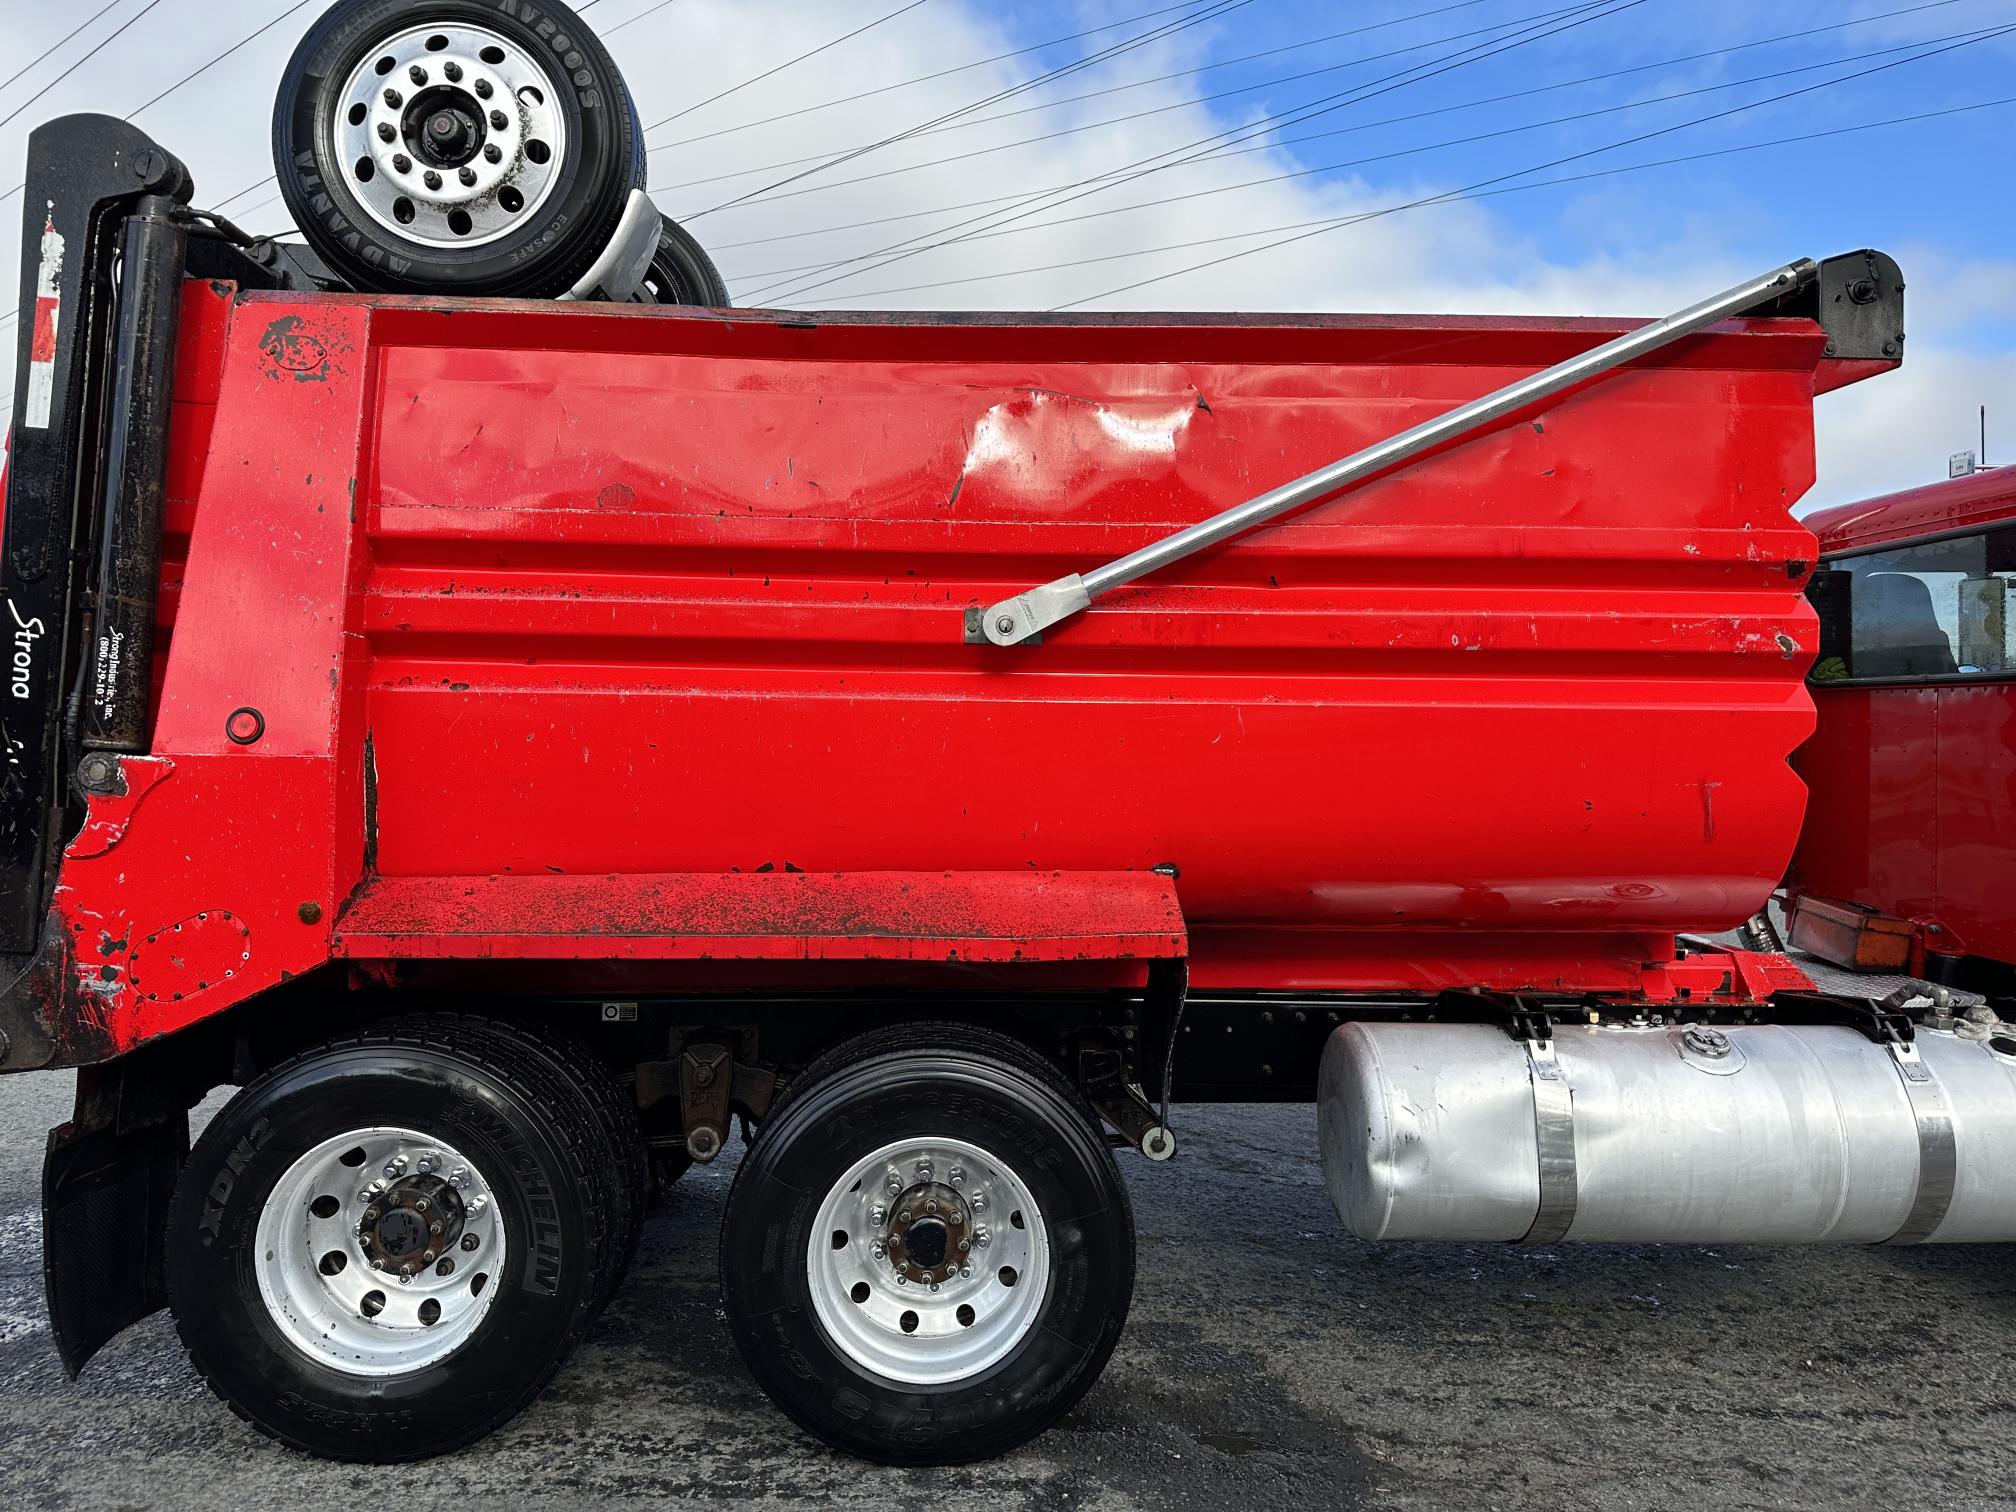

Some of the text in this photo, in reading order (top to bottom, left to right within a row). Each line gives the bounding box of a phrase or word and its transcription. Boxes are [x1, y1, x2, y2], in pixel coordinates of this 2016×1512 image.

[497, 0, 601, 108] AV2000S
[294, 148, 412, 279] ADVANTA
[94, 662, 107, 706] 229-102
[108, 625, 125, 660] Strong
[198, 1115, 274, 1238] XDN2
[478, 1108, 559, 1297] MICHELIN
